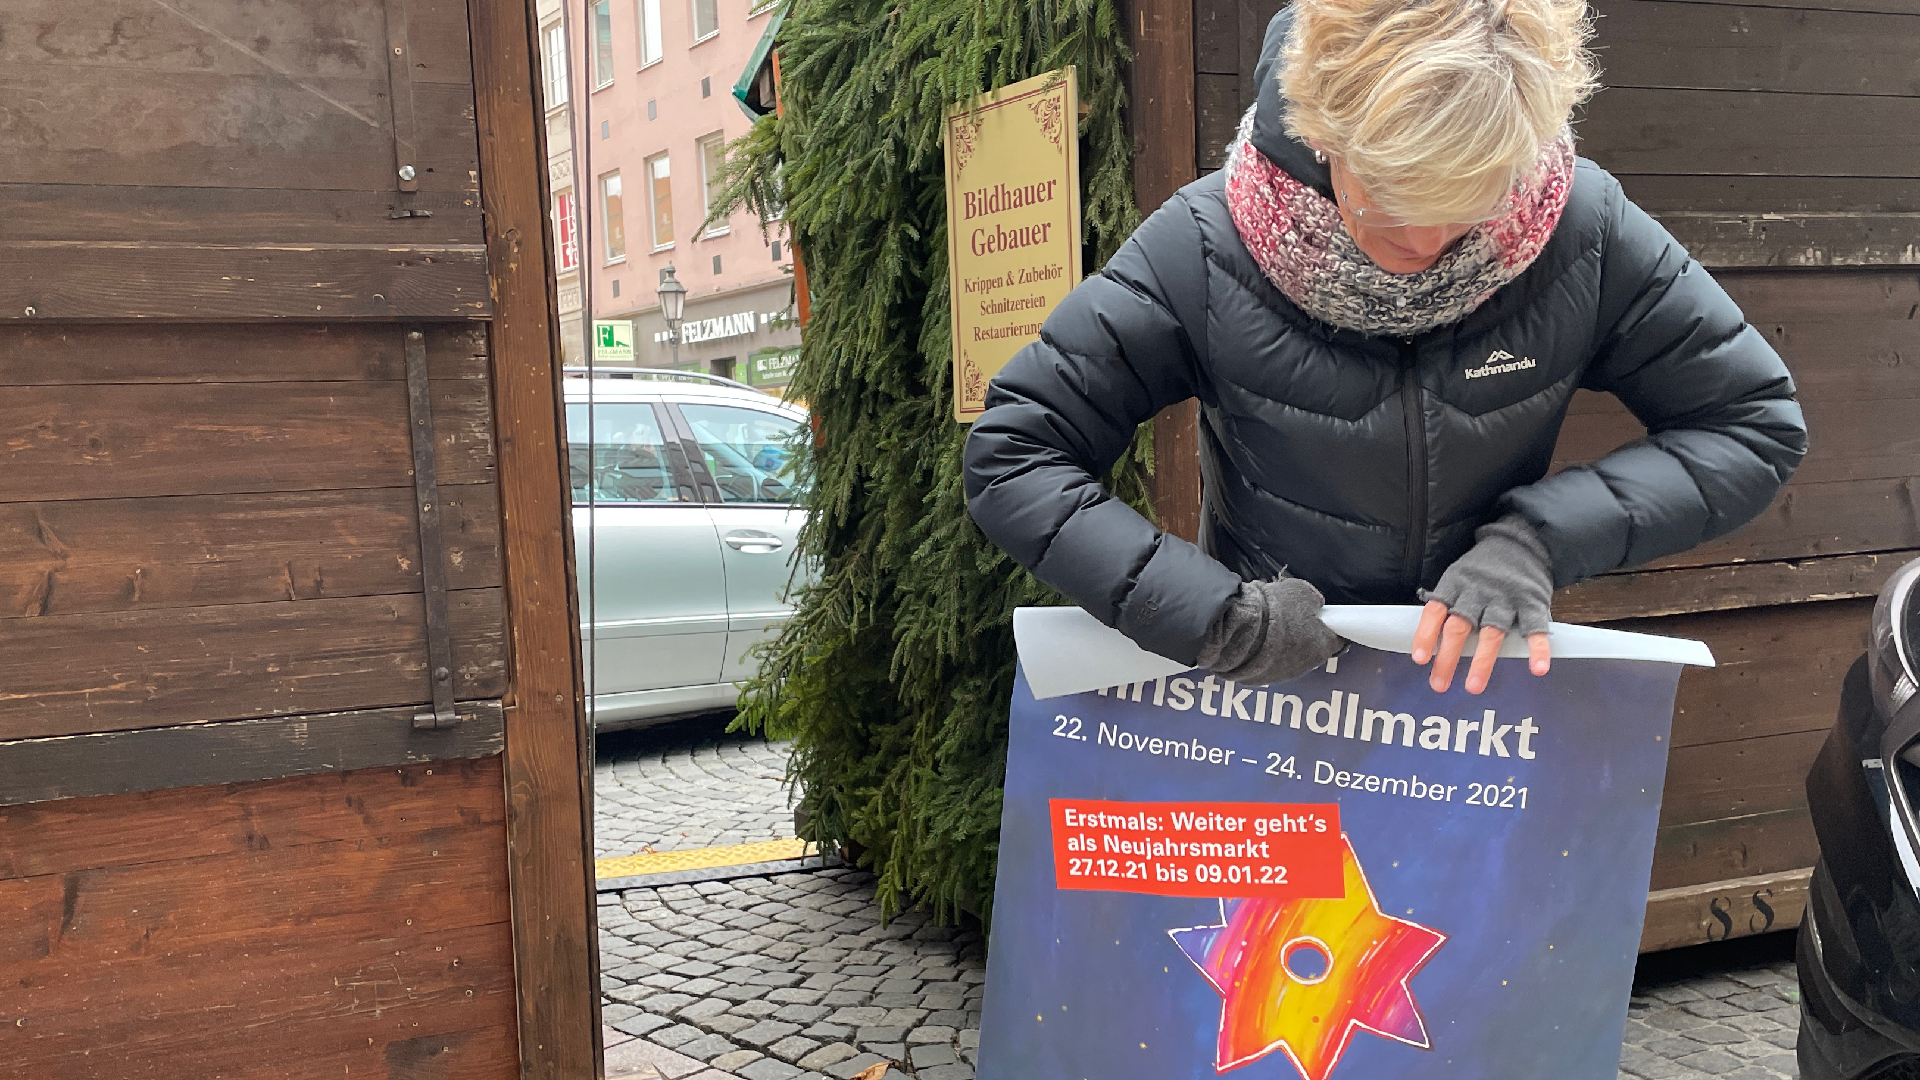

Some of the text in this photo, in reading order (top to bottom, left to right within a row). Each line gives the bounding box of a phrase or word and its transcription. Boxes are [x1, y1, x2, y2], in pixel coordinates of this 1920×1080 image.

[963, 178, 1057, 220] Bildhauer
[971, 222, 1052, 257] Gebauer
[964, 263, 1063, 295] Krippen & Zubehör
[980, 294, 1046, 316] Schnitzereien
[681, 310, 755, 345] FELZMANN
[973, 321, 1044, 342] Restaurierung
[1464, 356, 1537, 380] Kathmandu
[1097, 674, 1540, 760] ristkindlmarkt
[1052, 714, 1088, 742] 22.
[1097, 721, 1236, 766] November
[1265, 752, 1302, 780] 24.
[1313, 760, 1458, 802] Dezember
[1465, 782, 1529, 809] 2021
[1064, 808, 1164, 832] Erstmals:
[1170, 811, 1247, 832] Weiter
[1067, 833, 1271, 861] als Neujahrsmarkt
[1068, 858, 1289, 885] 27.12.21 bis 09.01.22
